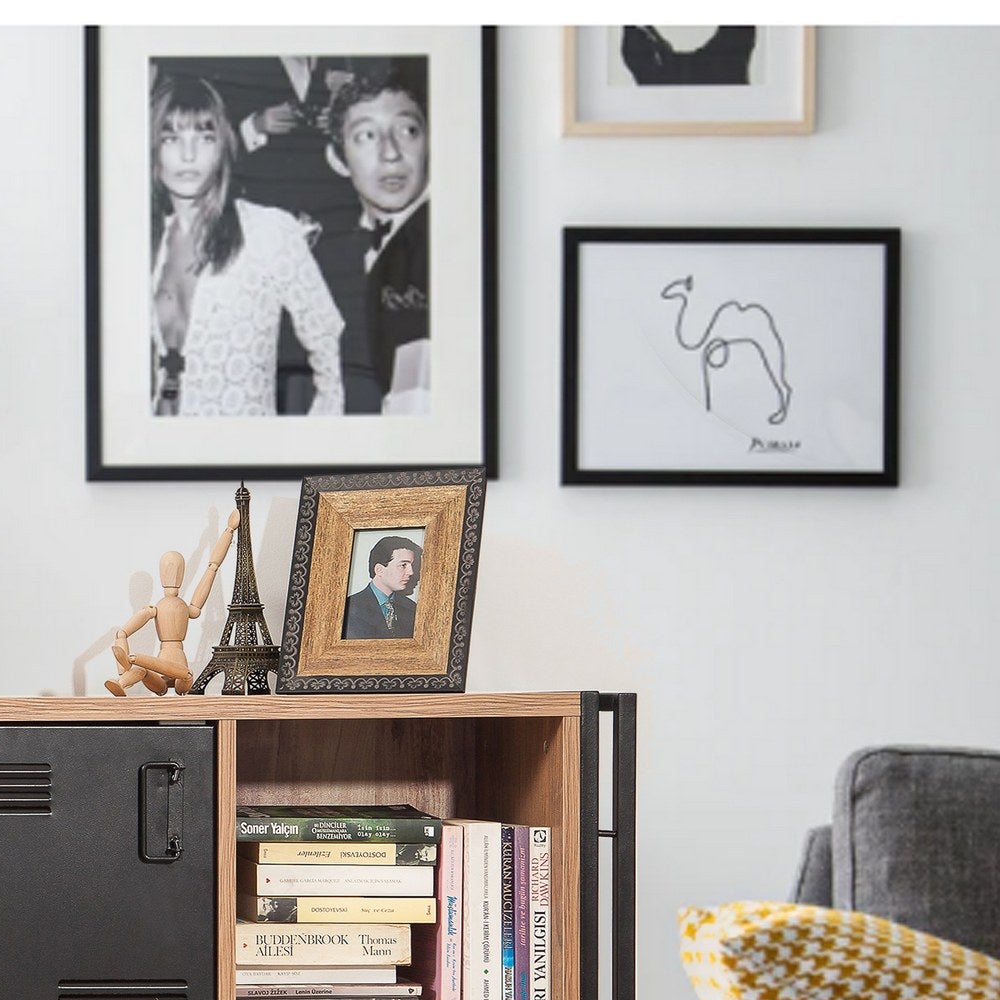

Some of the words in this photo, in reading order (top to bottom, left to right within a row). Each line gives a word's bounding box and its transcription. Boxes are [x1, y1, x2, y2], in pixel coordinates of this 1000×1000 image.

[240, 822, 269, 834] Soner
[270, 822, 299, 838] Yalçın
[316, 832, 352, 840] BENZEMİYOR
[539, 852, 548, 906] DAWKINS
[255, 933, 349, 945] BUDDENBROOK
[358, 934, 397, 945] Thomas
[255, 945, 293, 956] AİLESİ
[362, 946, 392, 956] Mann
[534, 911, 545, 981] YANILGISI
